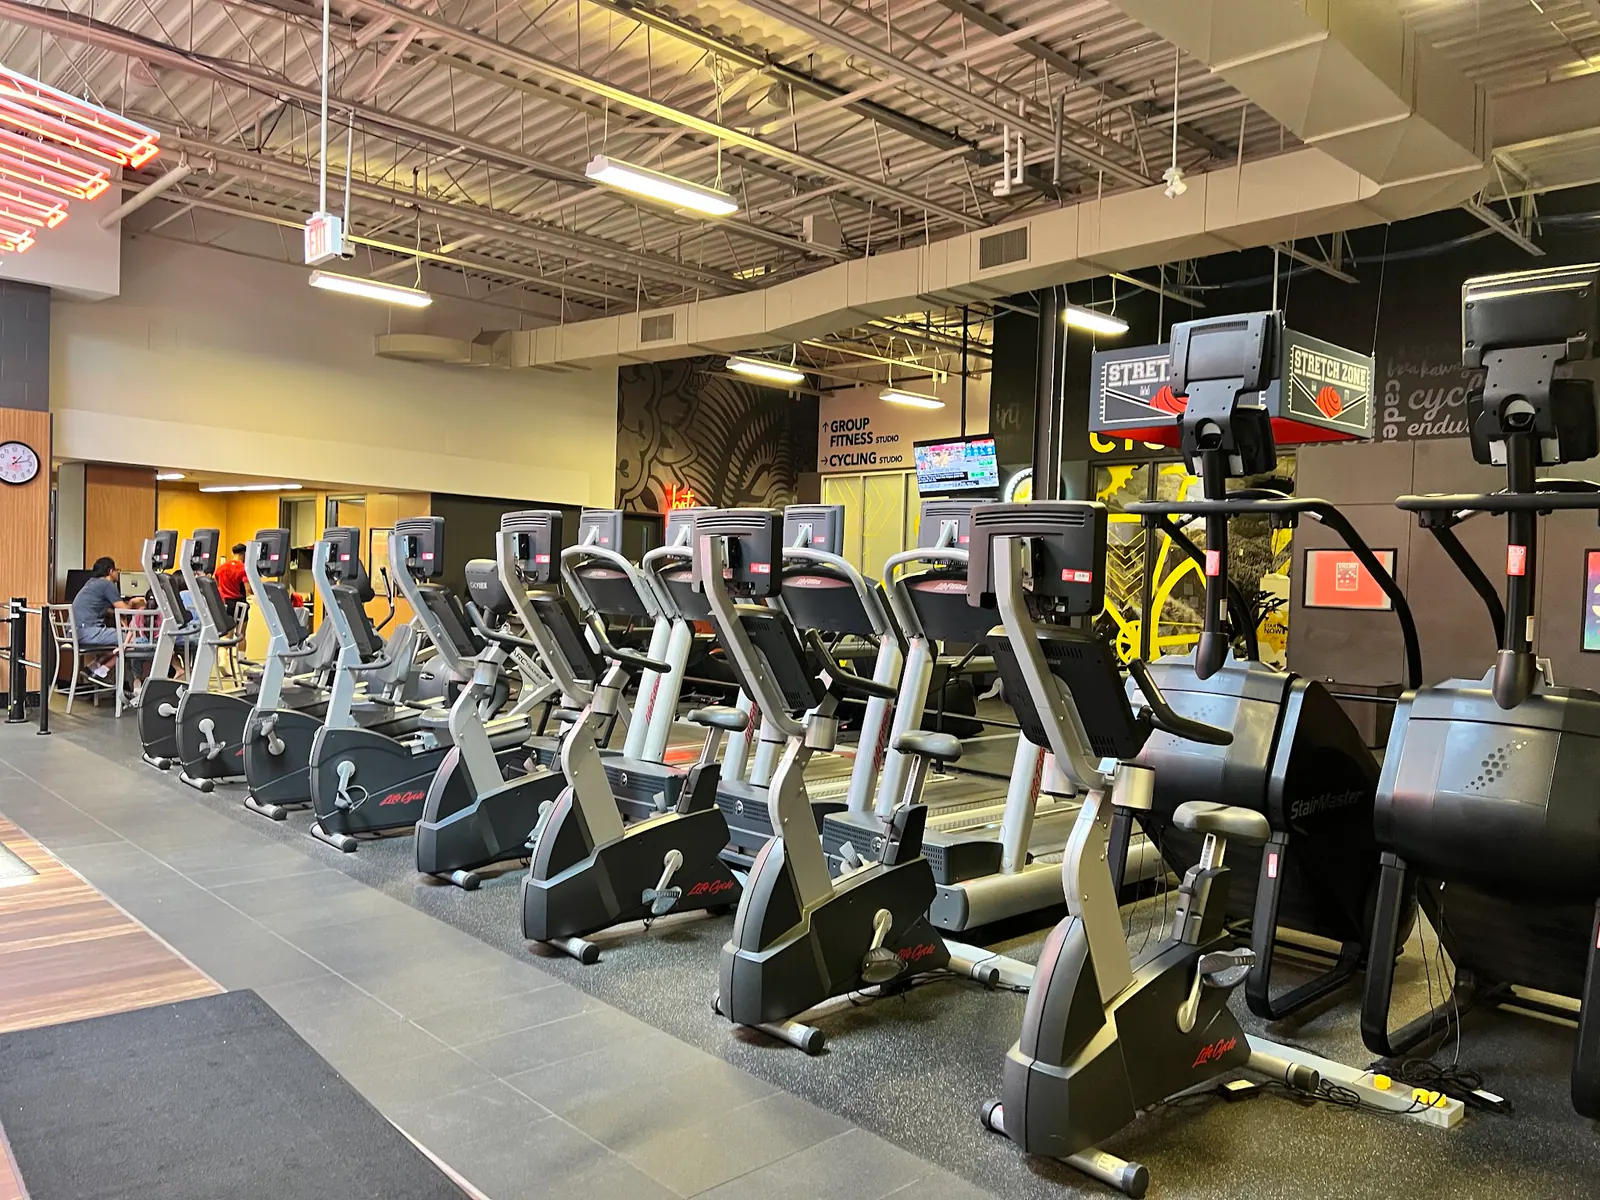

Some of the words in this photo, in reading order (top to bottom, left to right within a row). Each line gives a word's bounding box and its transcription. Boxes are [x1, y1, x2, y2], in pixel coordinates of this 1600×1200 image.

[1108, 360, 1170, 387] STRET
[1294, 349, 1341, 382] STRETCH
[1341, 363, 1367, 387] ZONE
[1408, 373, 1484, 421] cycl
[830, 417, 870, 433] GROUP
[830, 431, 874, 448] FITNESS
[875, 434, 899, 444] STUDIO
[829, 451, 877, 467] CYCLING
[879, 454, 903, 464] STUDIO
[1290, 788, 1364, 820] StairMaster
